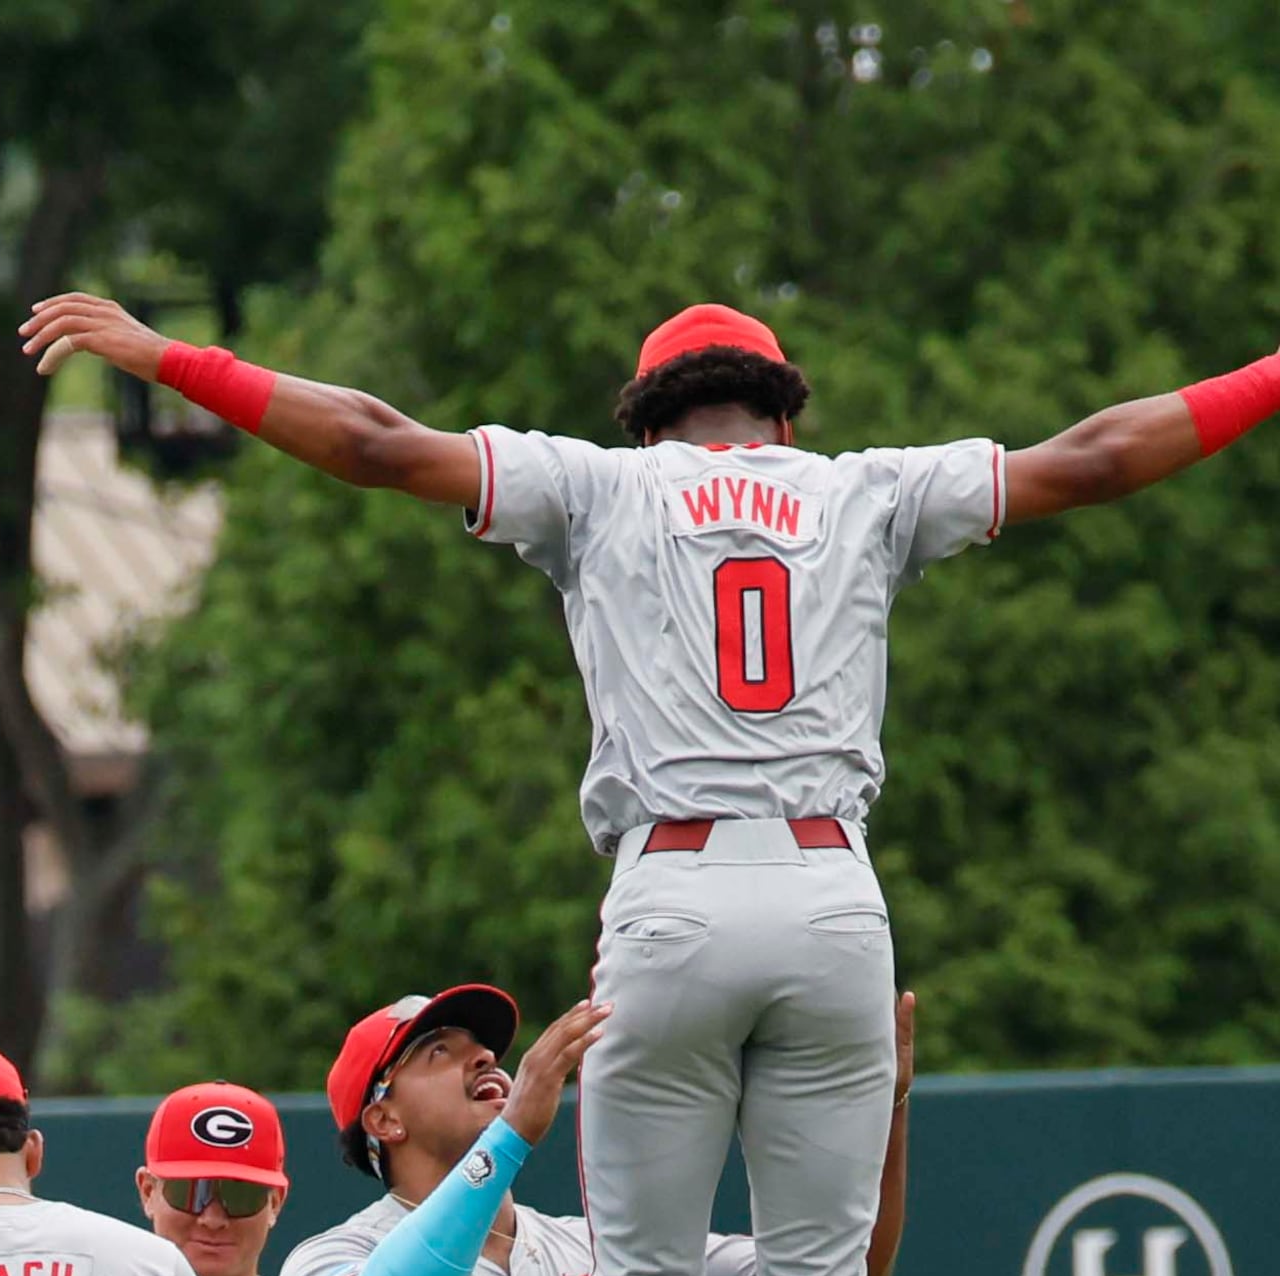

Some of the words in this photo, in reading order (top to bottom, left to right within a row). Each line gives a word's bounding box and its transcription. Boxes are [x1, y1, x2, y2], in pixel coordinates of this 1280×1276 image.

[681, 477, 801, 536] WYNN
[713, 556, 795, 713] 0
[190, 1106, 253, 1148] G
